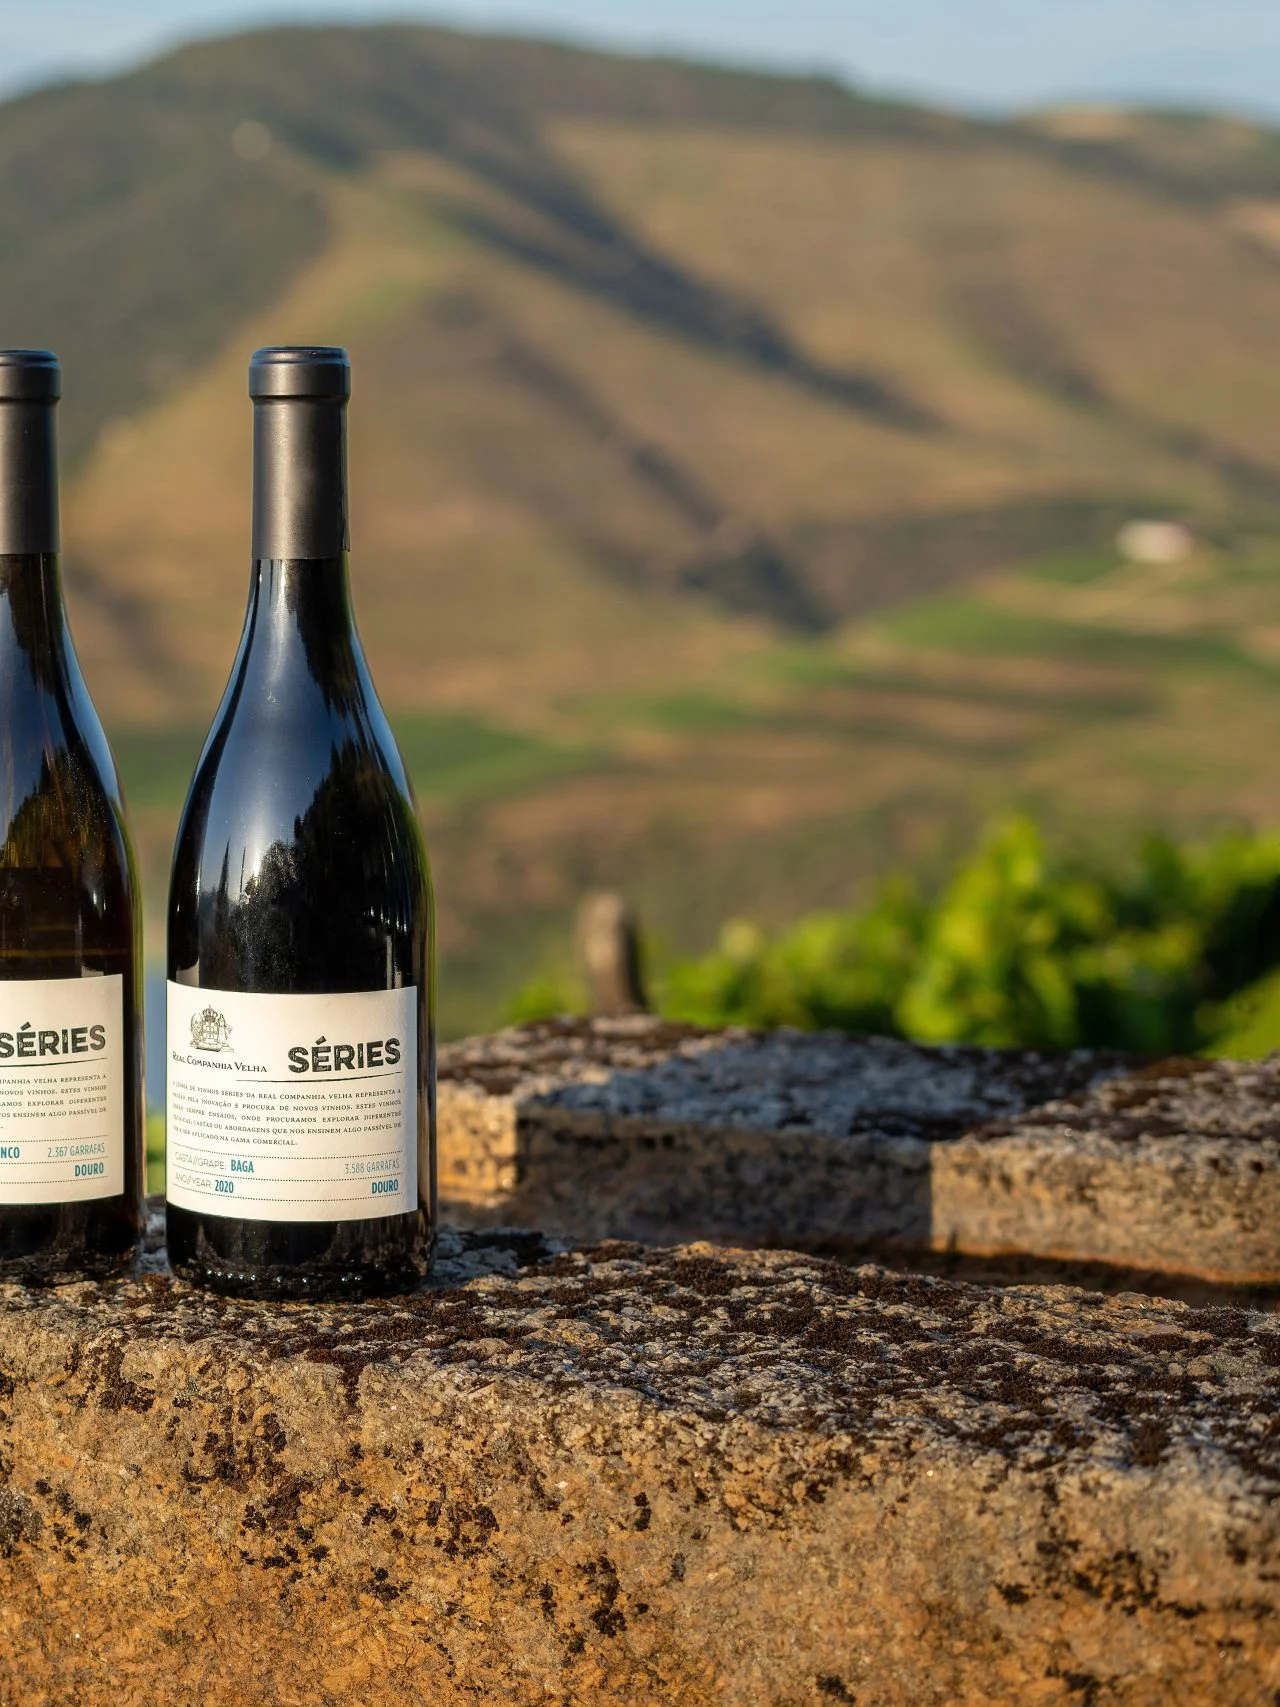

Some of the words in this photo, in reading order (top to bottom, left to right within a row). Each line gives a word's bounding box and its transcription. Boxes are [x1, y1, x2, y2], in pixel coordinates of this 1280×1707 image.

[288, 1035, 401, 1073] SÉRIES
[172, 1051, 185, 1063] REAL
[186, 1055, 233, 1070] COMPANHIA
[234, 1062, 268, 1073] VELHA
[60, 1075, 100, 1083] REPRESENTA
[83, 1084, 107, 1092] VINHOS
[197, 1087, 219, 1095] VINHOS
[221, 1089, 243, 1097] SÉRIES
[355, 1090, 396, 1098] REPRESENTA
[69, 1096, 107, 1105] DIFERENTES
[201, 1099, 232, 1108] INOVAÇÃO
[68, 1108, 98, 1116] PASSÍVEL
[208, 1111, 237, 1120] ENSAIOS,
[364, 1111, 401, 1120] DIFERENTES
[193, 1120, 213, 1128] CASTAS
[224, 1125, 270, 1133] ABORDAGENS
[272, 1127, 287, 1135] QUE
[363, 1124, 392, 1132] PASSÍVEL
[192, 1131, 219, 1140] APLICADO
[252, 1138, 298, 1146] COMERCIAL.
[48, 1146, 68, 1158] 2.367
[70, 1142, 105, 1156] GARRAFAS
[74, 1162, 104, 1177] DOURO
[231, 1159, 254, 1173] BAGA
[345, 1163, 365, 1174] 3.588
[367, 1158, 400, 1172] GARRAFAS
[215, 1180, 234, 1194] 2020
[371, 1179, 399, 1194] DOURO
